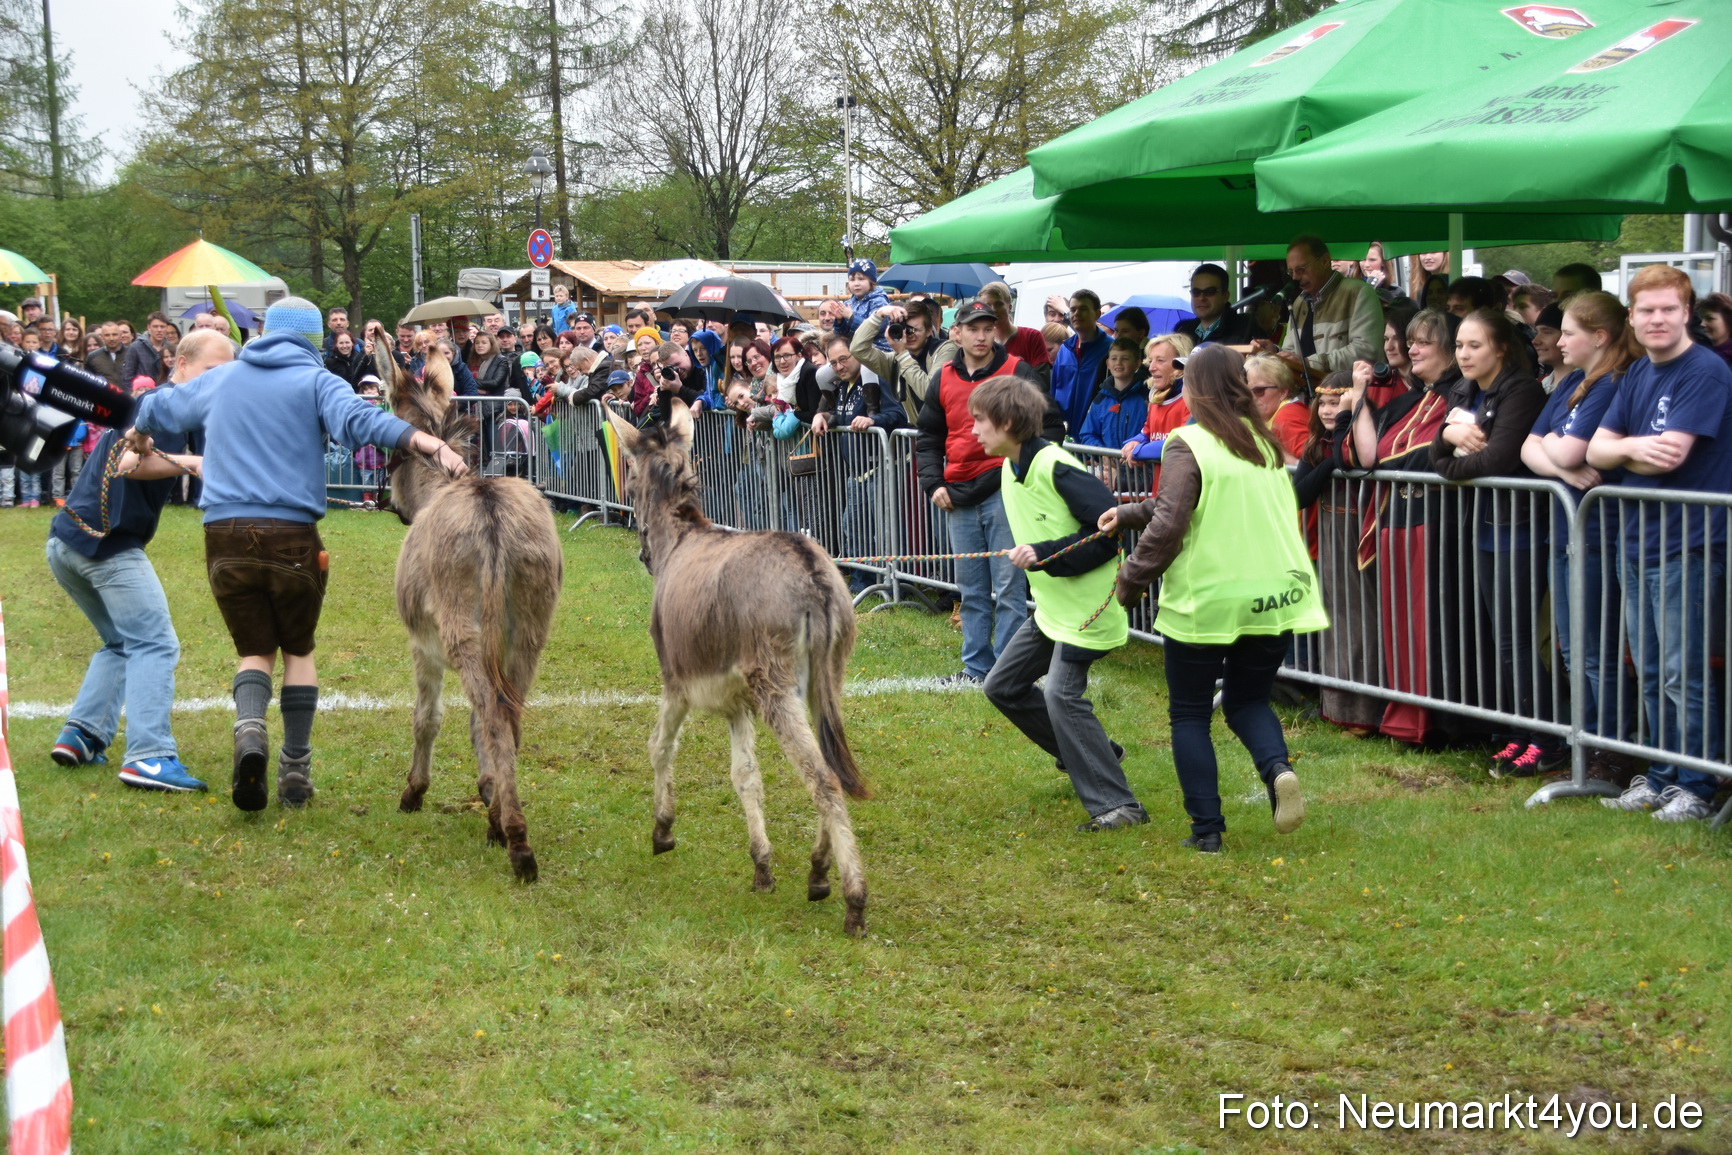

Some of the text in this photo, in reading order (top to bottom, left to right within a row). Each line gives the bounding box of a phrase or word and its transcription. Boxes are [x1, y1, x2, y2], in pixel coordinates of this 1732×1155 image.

[701, 288, 725, 299] ATI
[64, 363, 124, 393] neumarkt TV
[51, 387, 112, 418] neumarkt TV
[1250, 588, 1304, 614] JAKO
